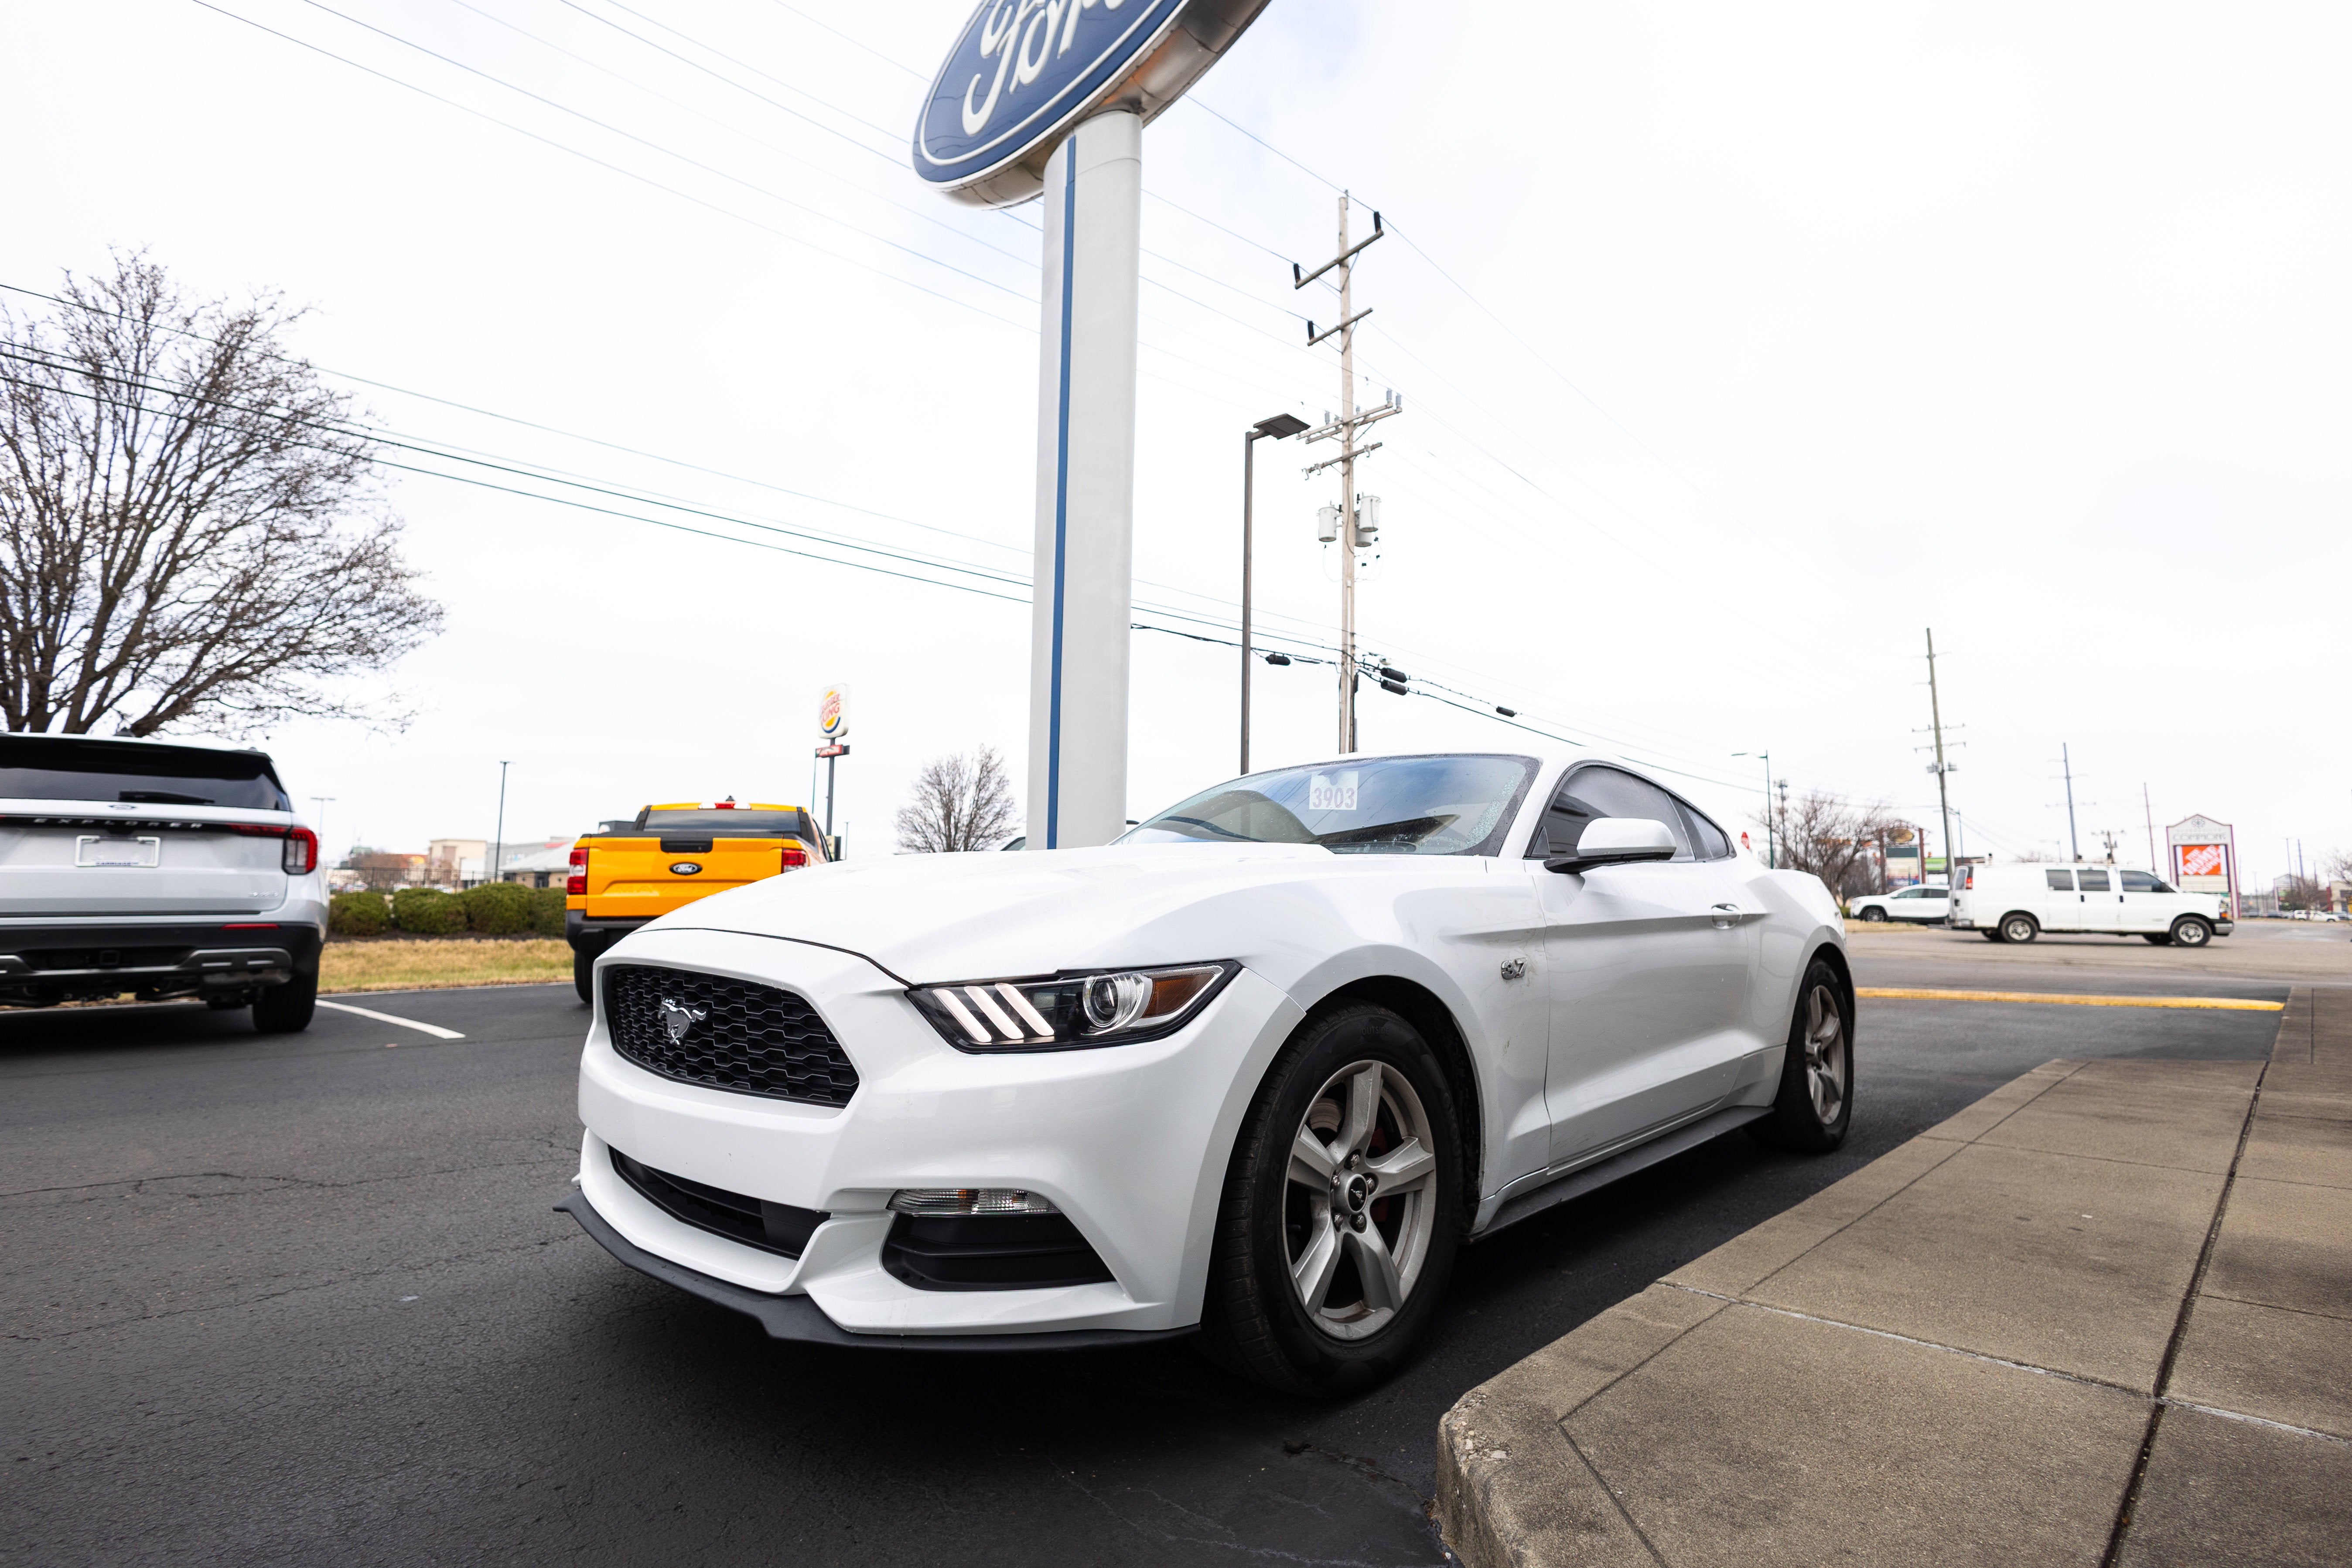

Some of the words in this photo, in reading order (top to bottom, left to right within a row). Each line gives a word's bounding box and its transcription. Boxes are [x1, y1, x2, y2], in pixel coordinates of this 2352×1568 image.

[962, 0, 1127, 136] For
[1312, 787, 1355, 809] 3903
[34, 817, 202, 829] EXPLORER
[2183, 845, 2219, 875] HOME
[1361, 1025, 1389, 1035] OUTSIDE
